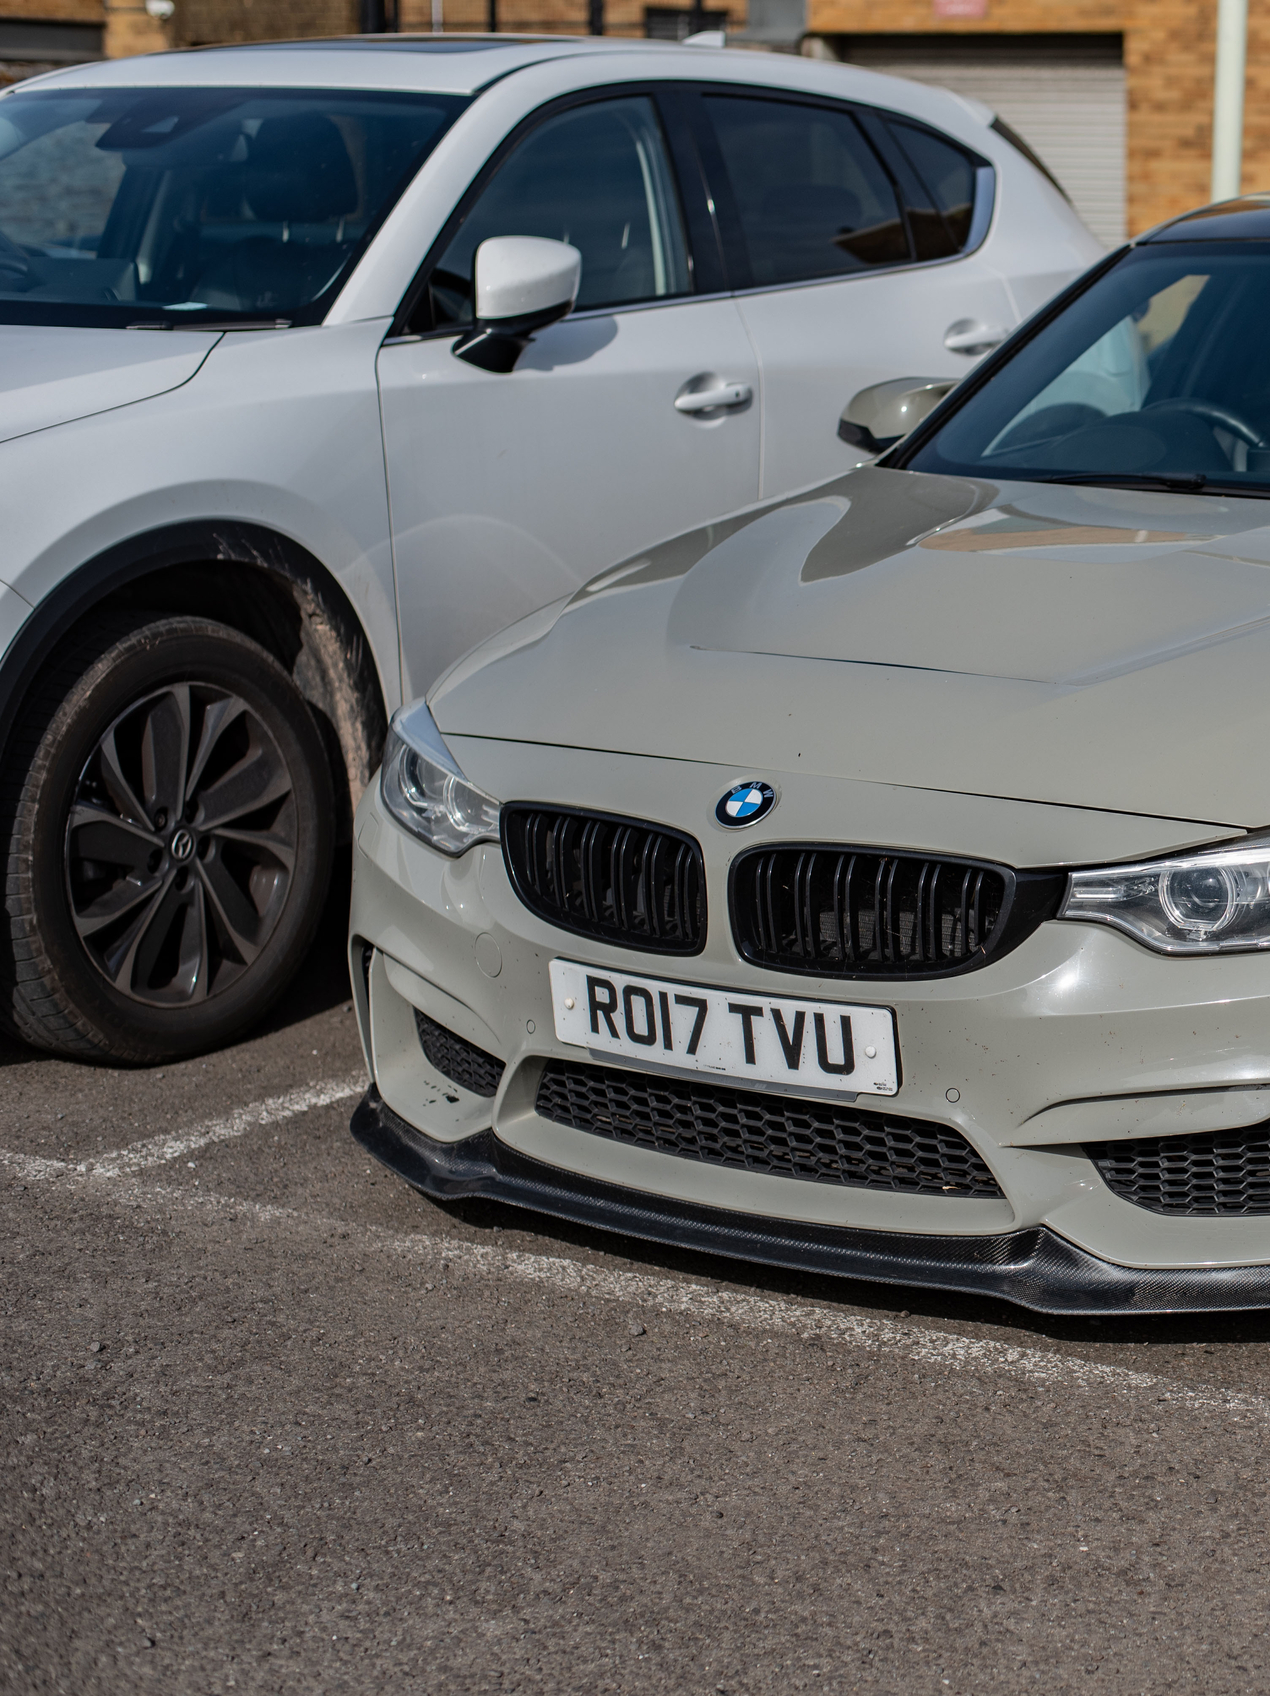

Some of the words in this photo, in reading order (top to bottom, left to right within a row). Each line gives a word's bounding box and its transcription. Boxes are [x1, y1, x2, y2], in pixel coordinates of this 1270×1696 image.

[730, 781, 774, 798] BMW
[586, 974, 709, 1056] RO17
[727, 1002, 855, 1076] TVU
